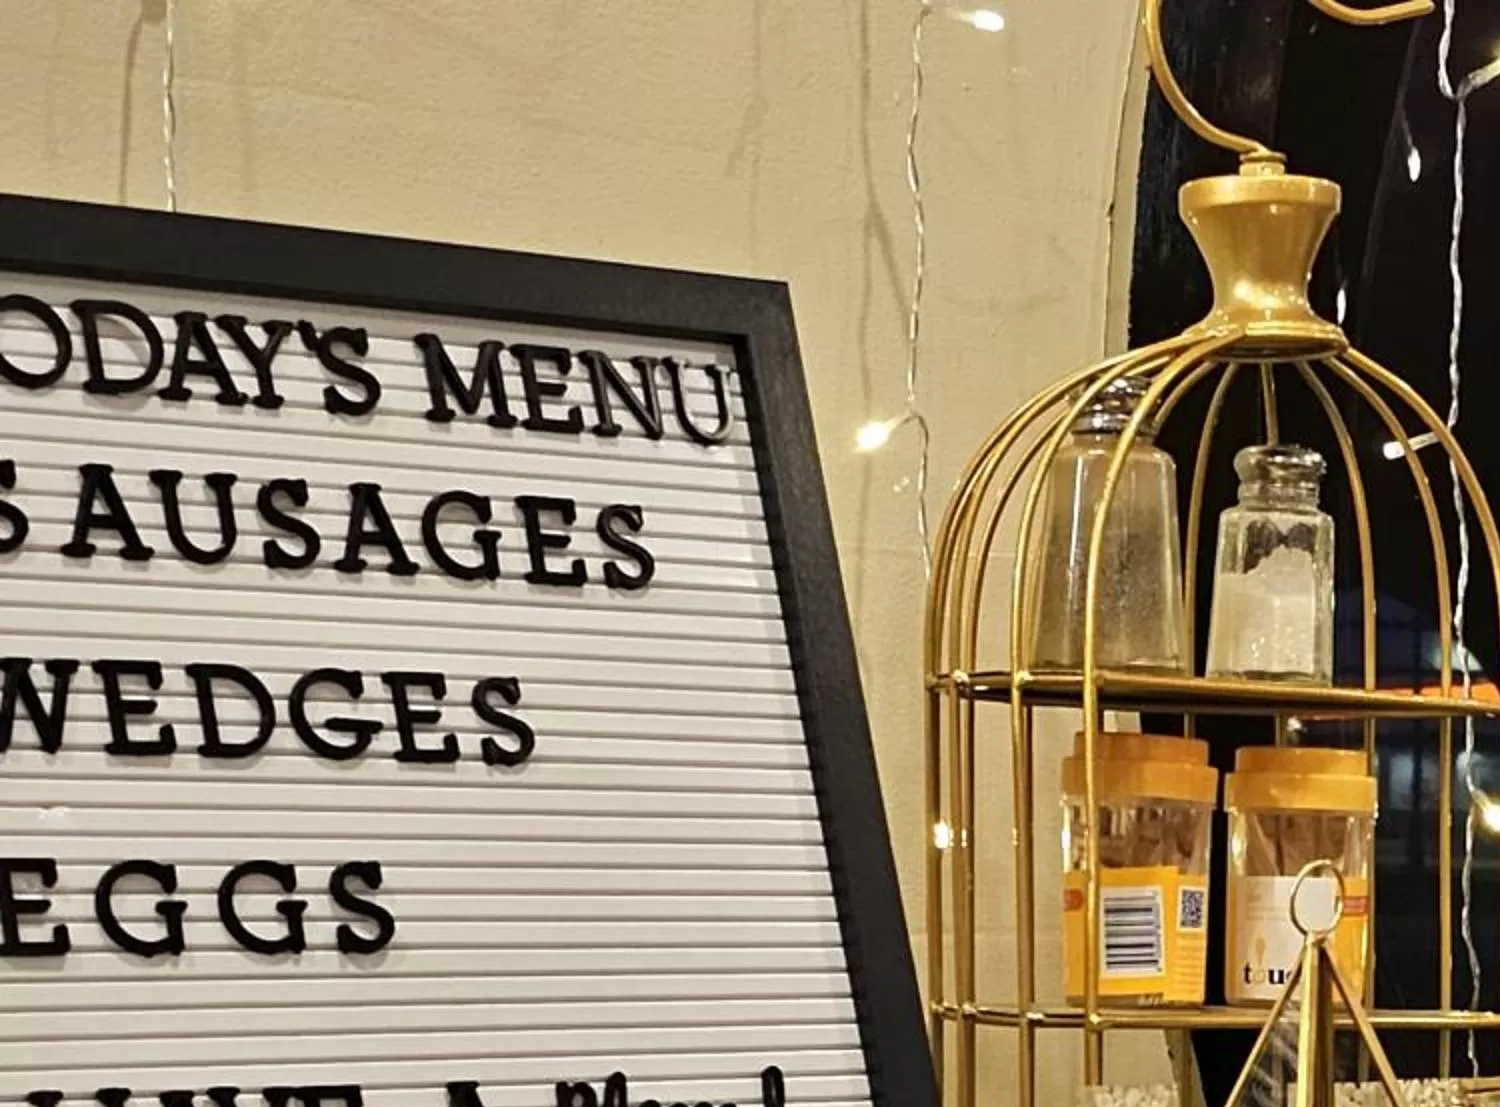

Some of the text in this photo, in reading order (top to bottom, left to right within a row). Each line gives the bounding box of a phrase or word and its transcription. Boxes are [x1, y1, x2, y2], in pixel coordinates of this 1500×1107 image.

[414, 332, 736, 447] MENU
[0, 656, 536, 766] WEDGES
[0, 858, 396, 957] EGGS
